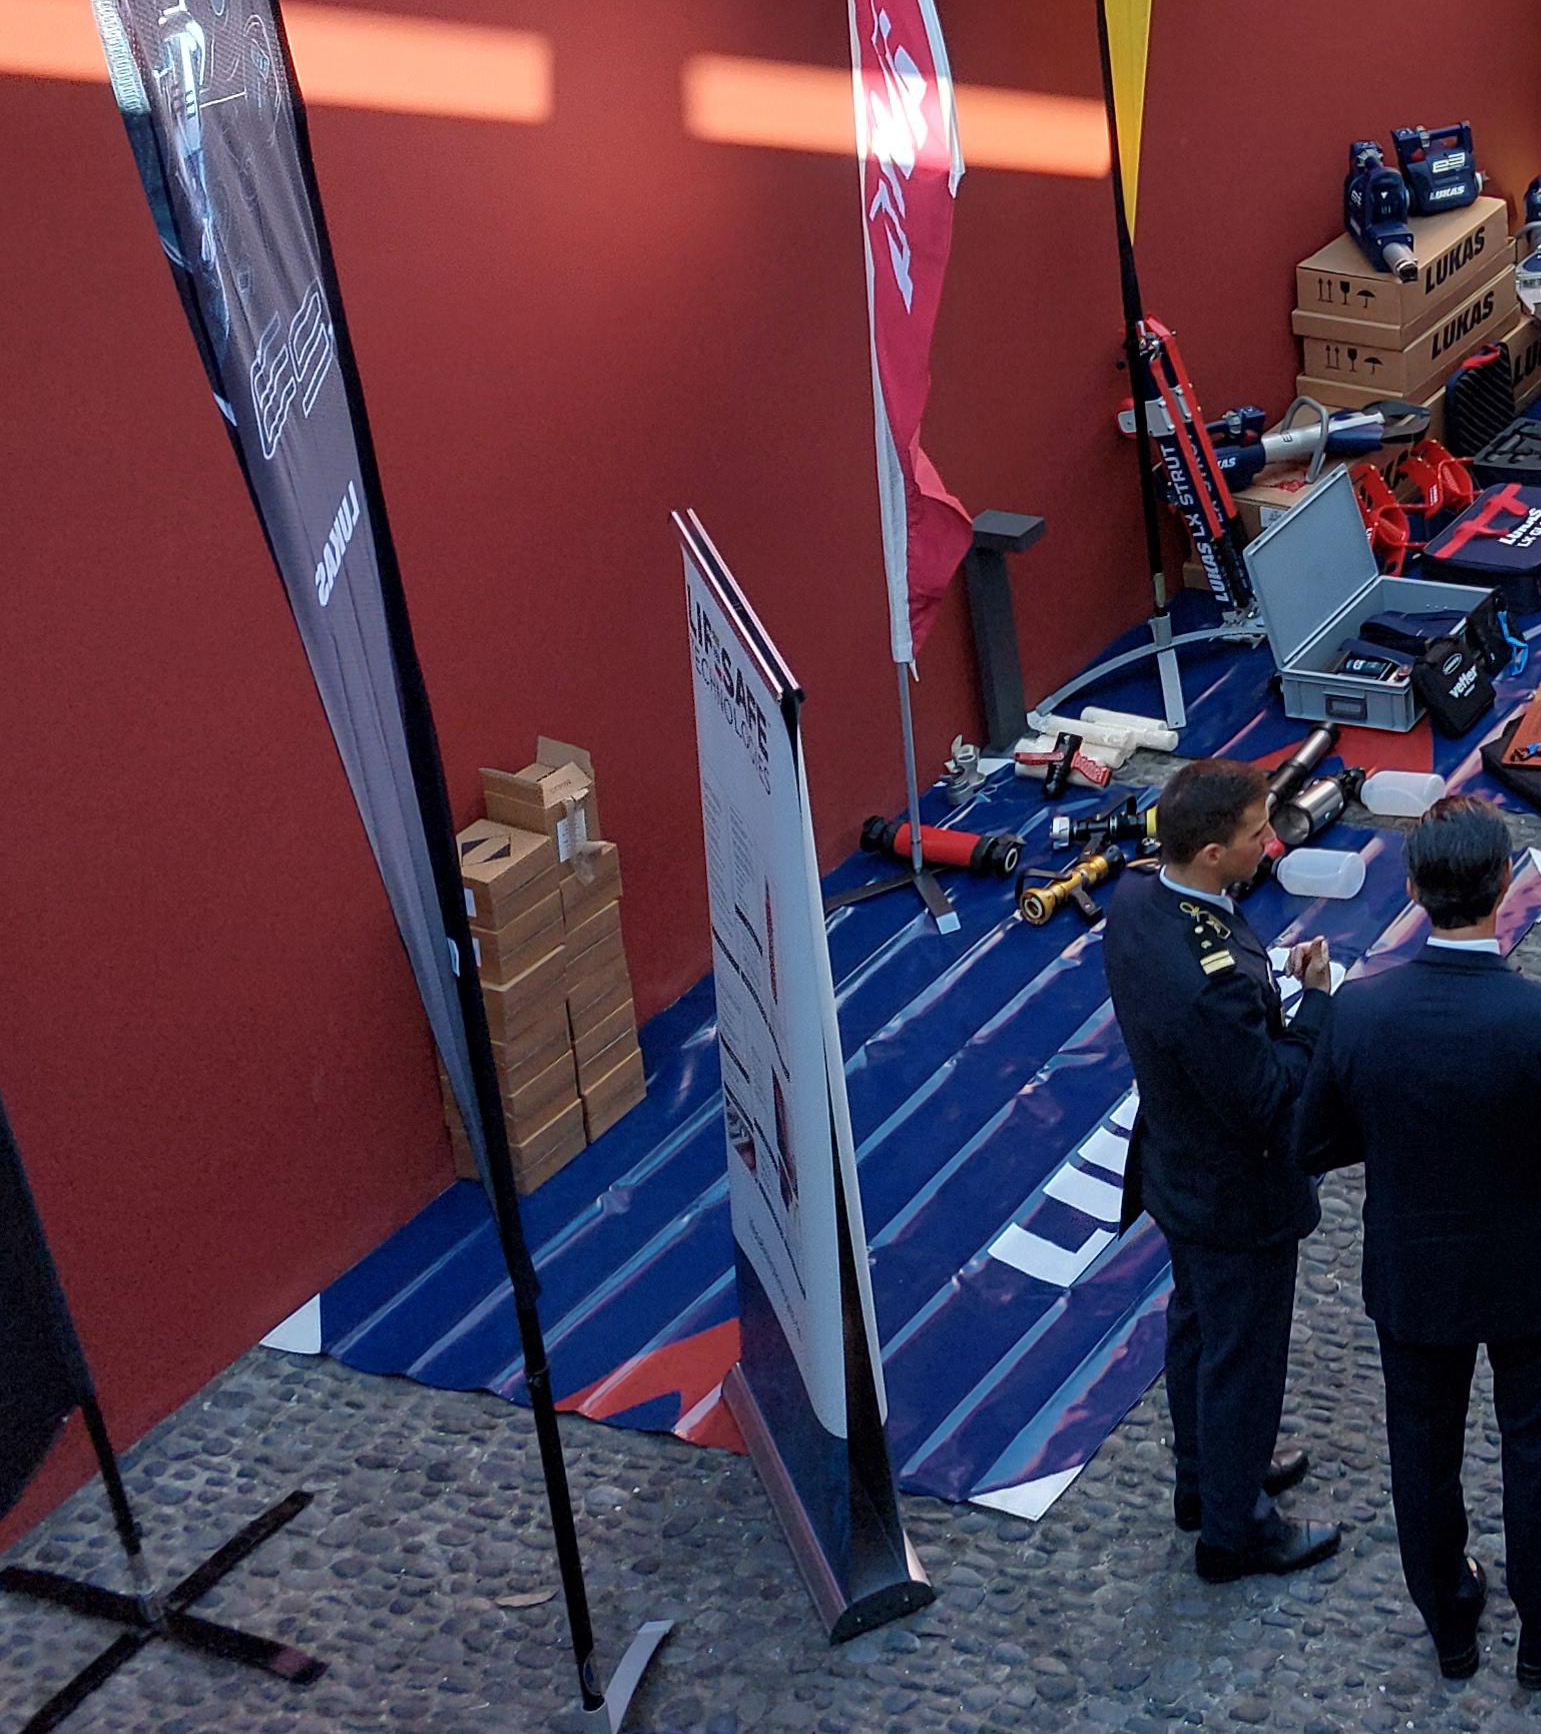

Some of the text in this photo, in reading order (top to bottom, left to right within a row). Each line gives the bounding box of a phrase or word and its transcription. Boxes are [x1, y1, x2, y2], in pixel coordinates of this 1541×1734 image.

[1429, 185, 1465, 201] LUKAS
[1425, 227, 1485, 295] LUKAS
[1431, 291, 1494, 360] LUKAS
[1161, 444, 1194, 506] STRUT
[1185, 514, 1206, 540] LX
[1516, 533, 1536, 547] LX
[1200, 542, 1230, 602] LUKAS
[1449, 665, 1478, 698] vetter
